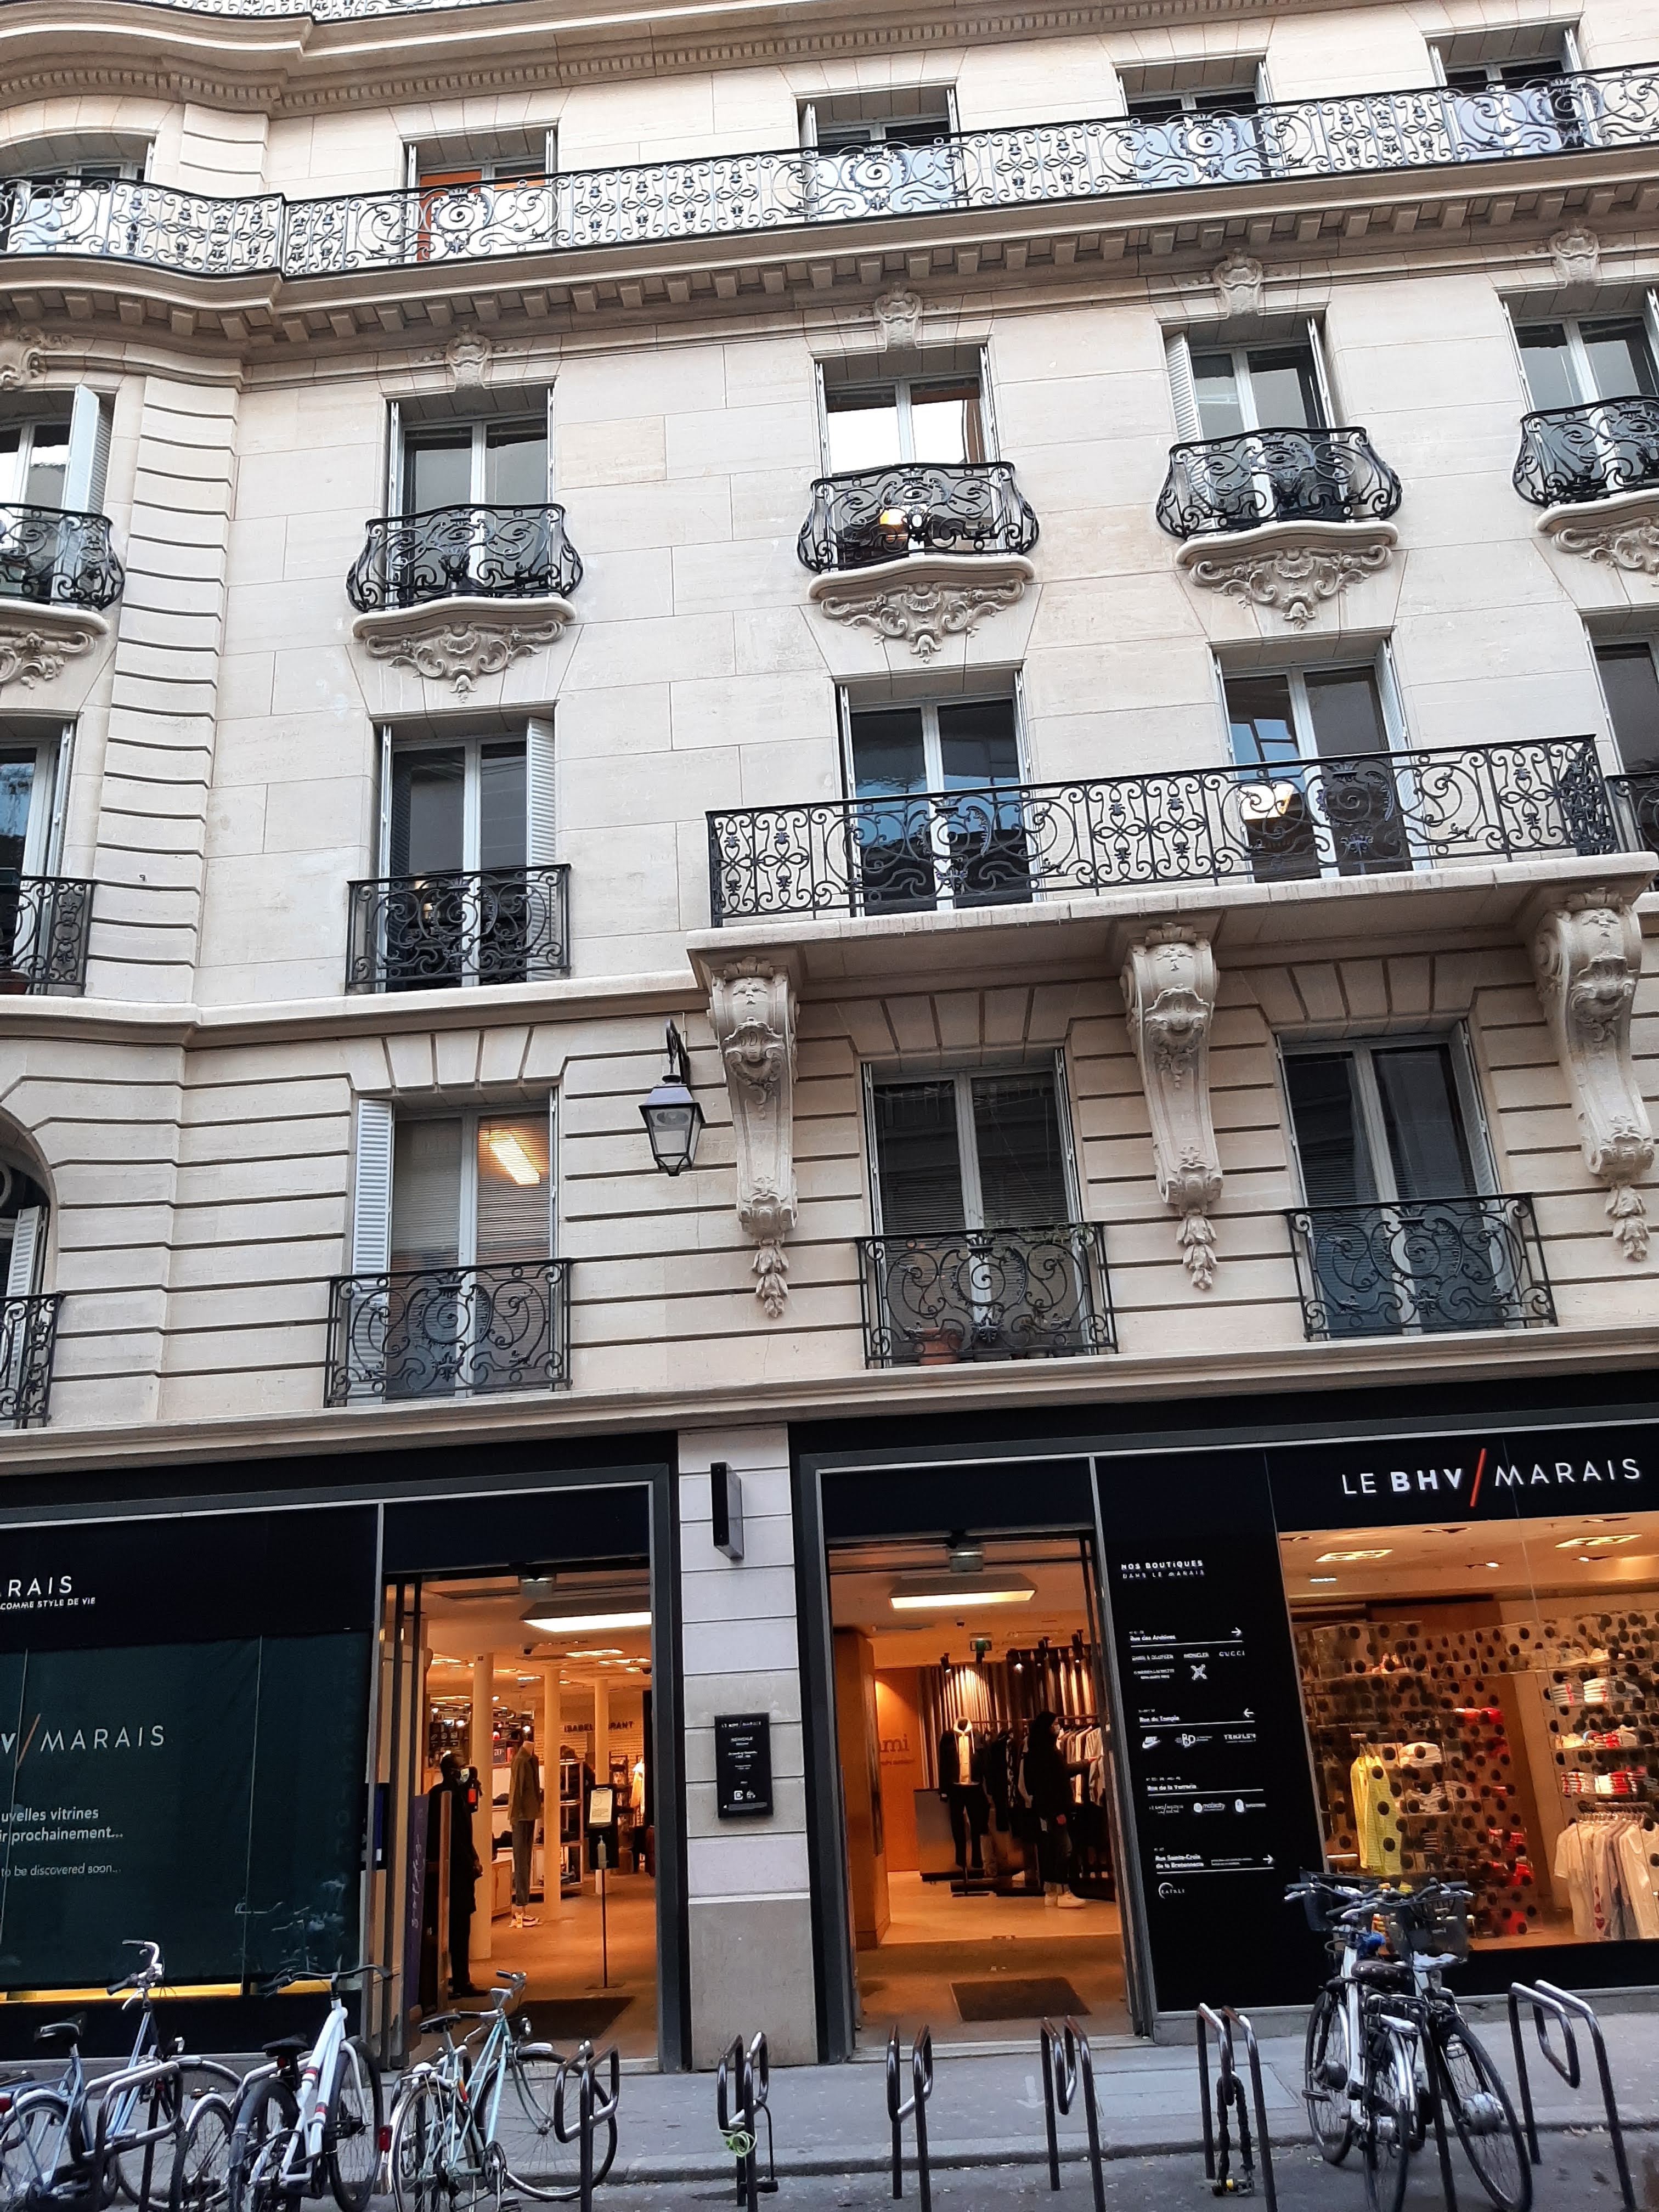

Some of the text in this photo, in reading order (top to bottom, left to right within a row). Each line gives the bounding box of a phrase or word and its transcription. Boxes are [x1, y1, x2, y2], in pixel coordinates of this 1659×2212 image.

[1342, 1472, 1377, 1495] LE
[1390, 1468, 1463, 1492] BHV
[1494, 1458, 1640, 1487] MARAIS
[1145, 1560, 1203, 1569] BOUTIQUES
[0, 1576, 72, 1597] RAIS
[0, 1597, 96, 1611] COMME STYLE DE VIE
[608, 1720, 634, 1730] RANT
[40, 1725, 165, 1752] MARAIS
[879, 1734, 910, 1753] mi
[1, 1806, 99, 1822] uvelles vitrines
[14, 1865, 27, 1877] be
[30, 1863, 86, 1876] discovered
